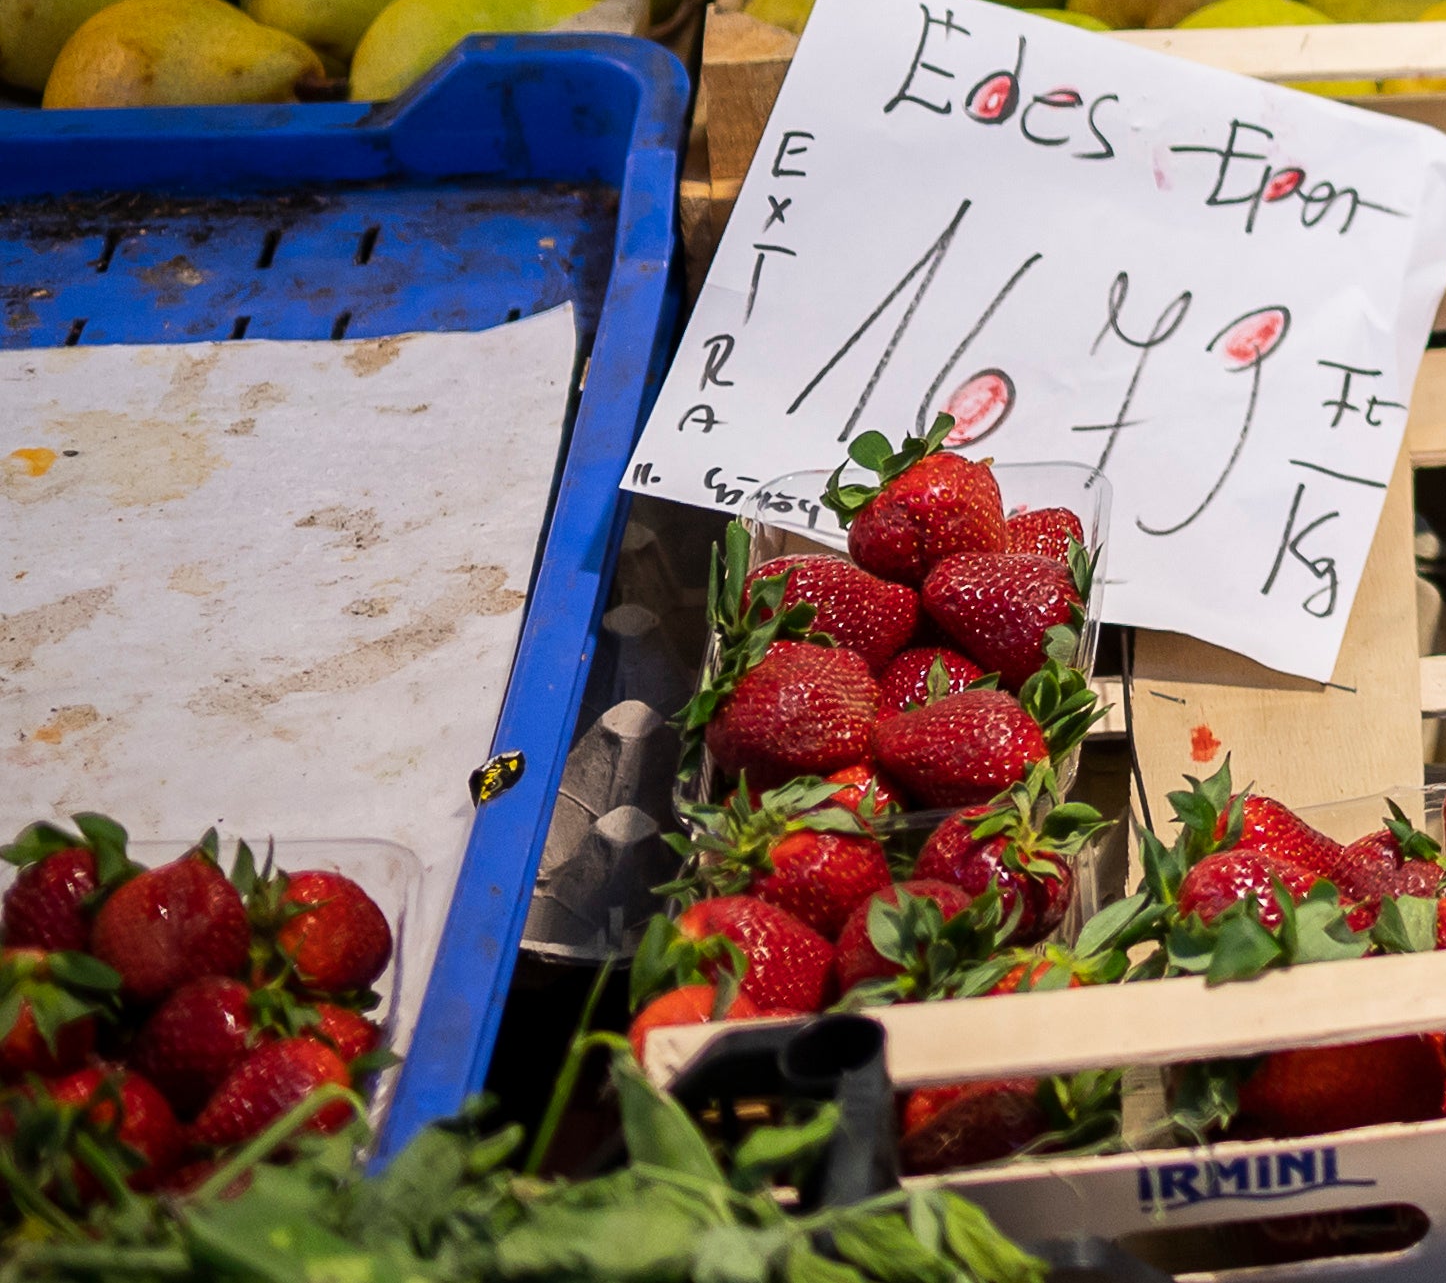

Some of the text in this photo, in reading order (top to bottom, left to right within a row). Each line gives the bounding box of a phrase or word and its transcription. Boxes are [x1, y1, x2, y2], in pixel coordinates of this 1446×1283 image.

[678, 132, 816, 434] EXTRA
[787, 198, 1292, 537] 1679
[1319, 359, 1409, 429] Ft
[1137, 1147, 1337, 1203] IRMINI
